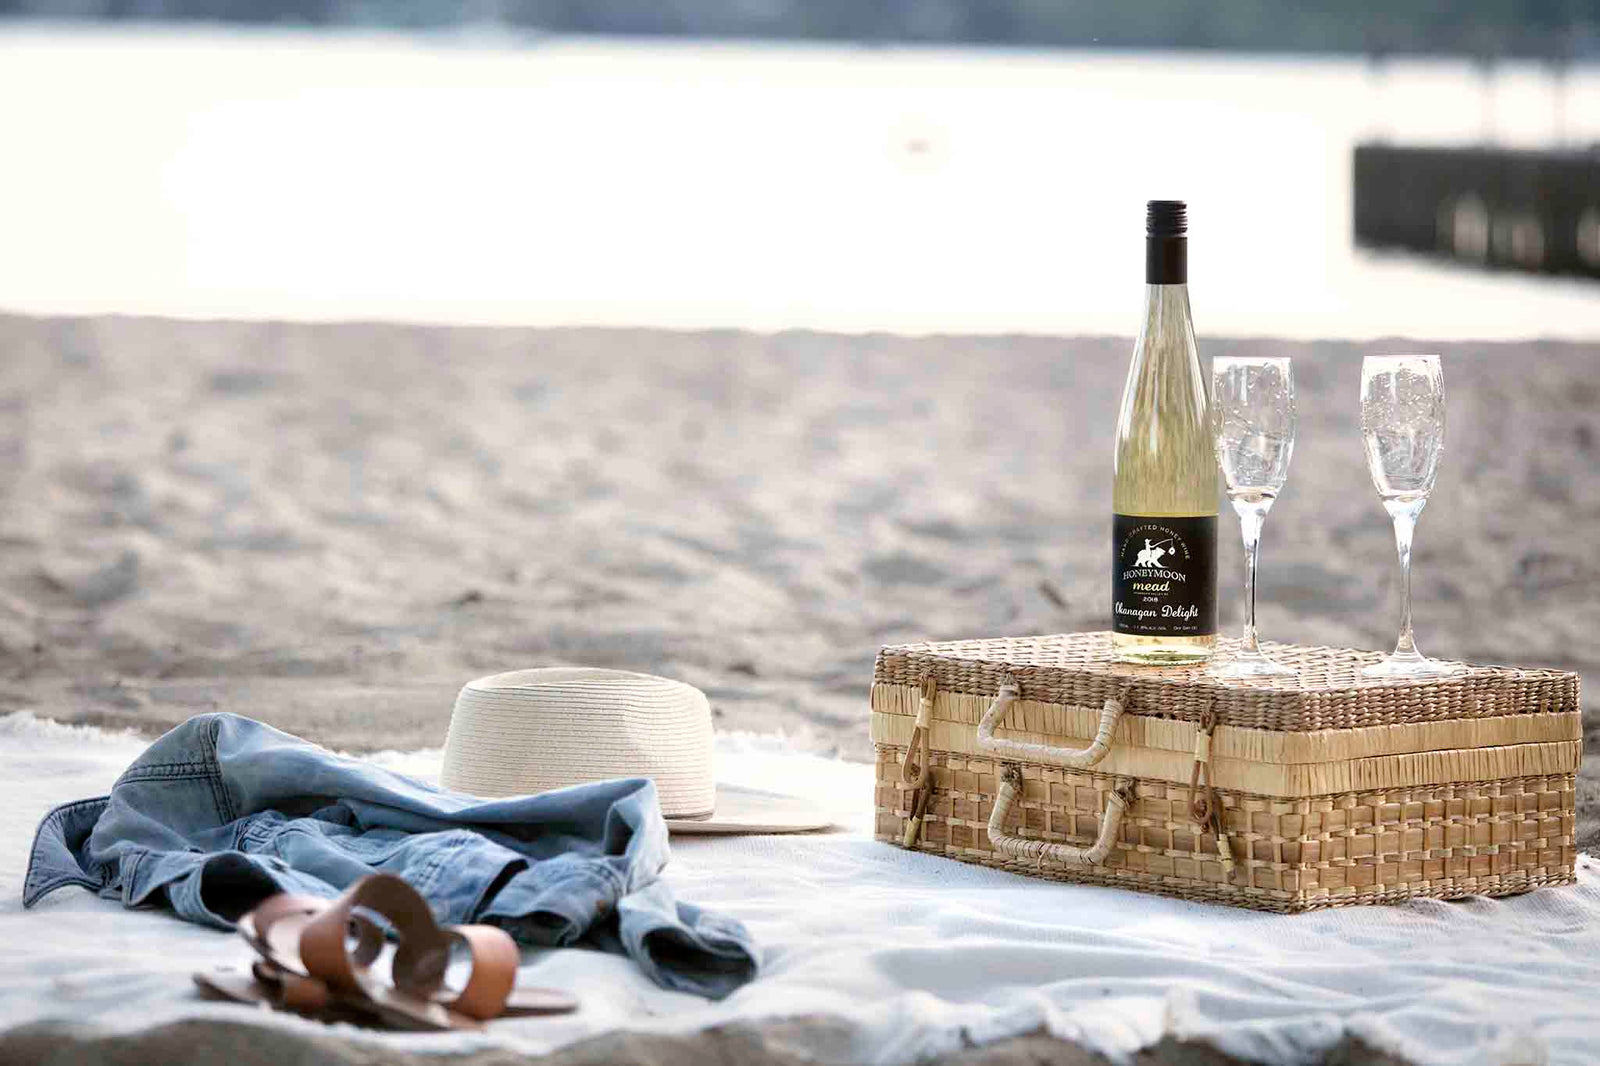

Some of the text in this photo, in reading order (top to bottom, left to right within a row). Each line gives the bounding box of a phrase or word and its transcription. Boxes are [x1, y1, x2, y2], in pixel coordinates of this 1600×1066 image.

[1159, 527, 1182, 541] HONEY
[1123, 569, 1186, 582] HONEYMOON
[1132, 581, 1170, 591] mead
[1115, 601, 1199, 621] Okanagan Delight
